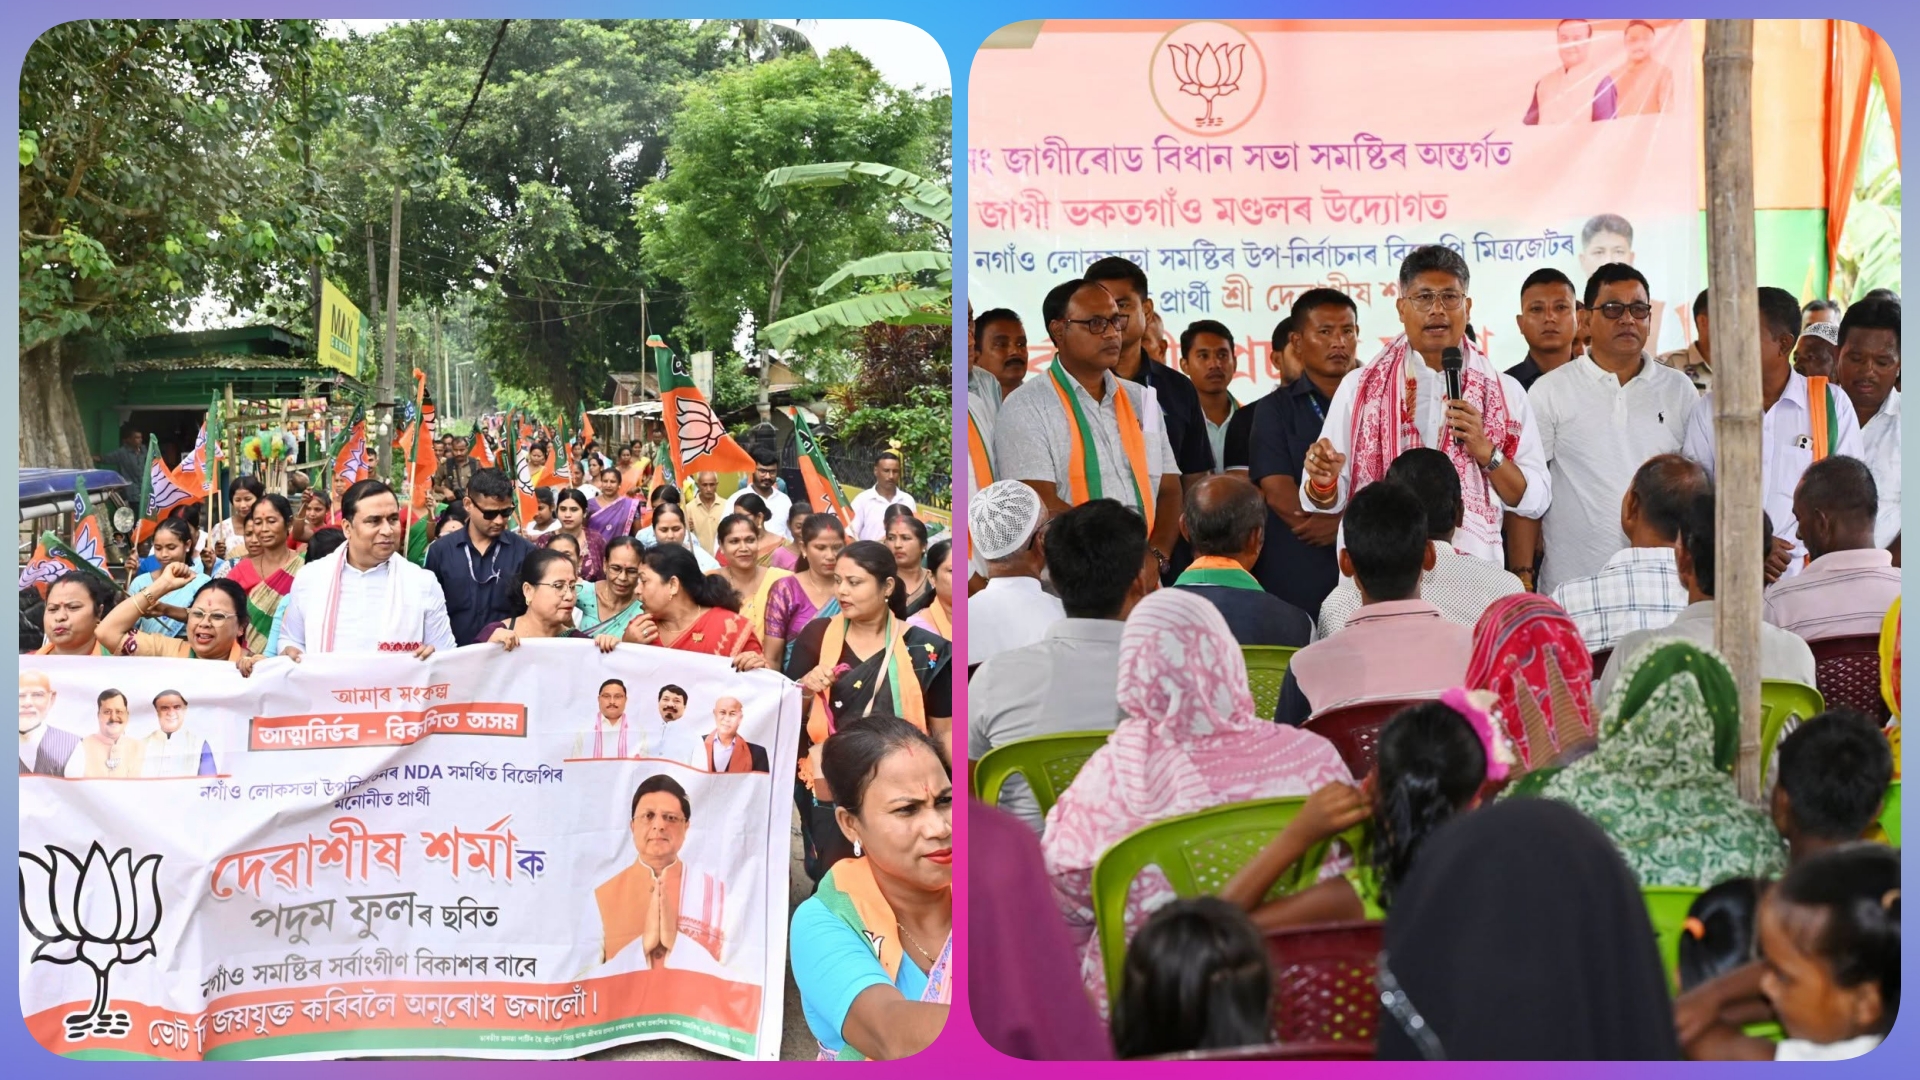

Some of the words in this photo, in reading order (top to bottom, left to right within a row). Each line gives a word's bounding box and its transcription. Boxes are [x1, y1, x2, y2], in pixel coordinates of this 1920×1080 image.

[1001, 136, 1144, 176] জাগীৰোড
[1152, 134, 1233, 174] বিধান
[1241, 141, 1299, 173] সভা
[1308, 132, 1406, 172] সমষ্টিৰ
[1415, 130, 1513, 171] অন্তৰ্গত
[976, 188, 1052, 231] জাগী
[1062, 187, 1201, 229] ভকতগাঁও
[1212, 197, 1312, 226] মণ্ডলৰ
[1320, 185, 1448, 226] উদ্যোগত
[974, 243, 1036, 274] নগাঁও
[1047, 246, 1150, 274] লোকভা
[1157, 239, 1235, 270] সমষ্টিৰ
[1160, 281, 1211, 313] প্ৰাৰ্থী
[1222, 273, 1254, 312] শ্ৰী
[331, 303, 353, 346] MAX
[331, 686, 392, 710] আমাৰ
[397, 683, 450, 704] সংকল্প
[258, 716, 360, 746] আত্মনিৰ্ভৰ
[466, 711, 518, 730] অসম
[200, 780, 242, 801] নগাঁও
[248, 780, 317, 800] লোকসভা
[404, 764, 443, 780] NDA
[447, 760, 498, 781] সমৰ্থিত
[501, 762, 564, 784] বিজেপিৰ
[334, 787, 394, 810] মনোনীত
[397, 785, 431, 807] প্ৰাৰ্থী
[250, 899, 337, 945] পদুম
[441, 896, 500, 933] ছবিত
[252, 954, 322, 984] সমষ্টিৰ
[415, 947, 488, 977] বিকাশৰ
[494, 954, 537, 978] বাবে
[149, 1014, 189, 1051] ভোট
[211, 1001, 294, 1034] জয়যুক্ত
[301, 987, 396, 1023] কৰিবলৈ
[403, 990, 497, 1025] অনুৰোধ
